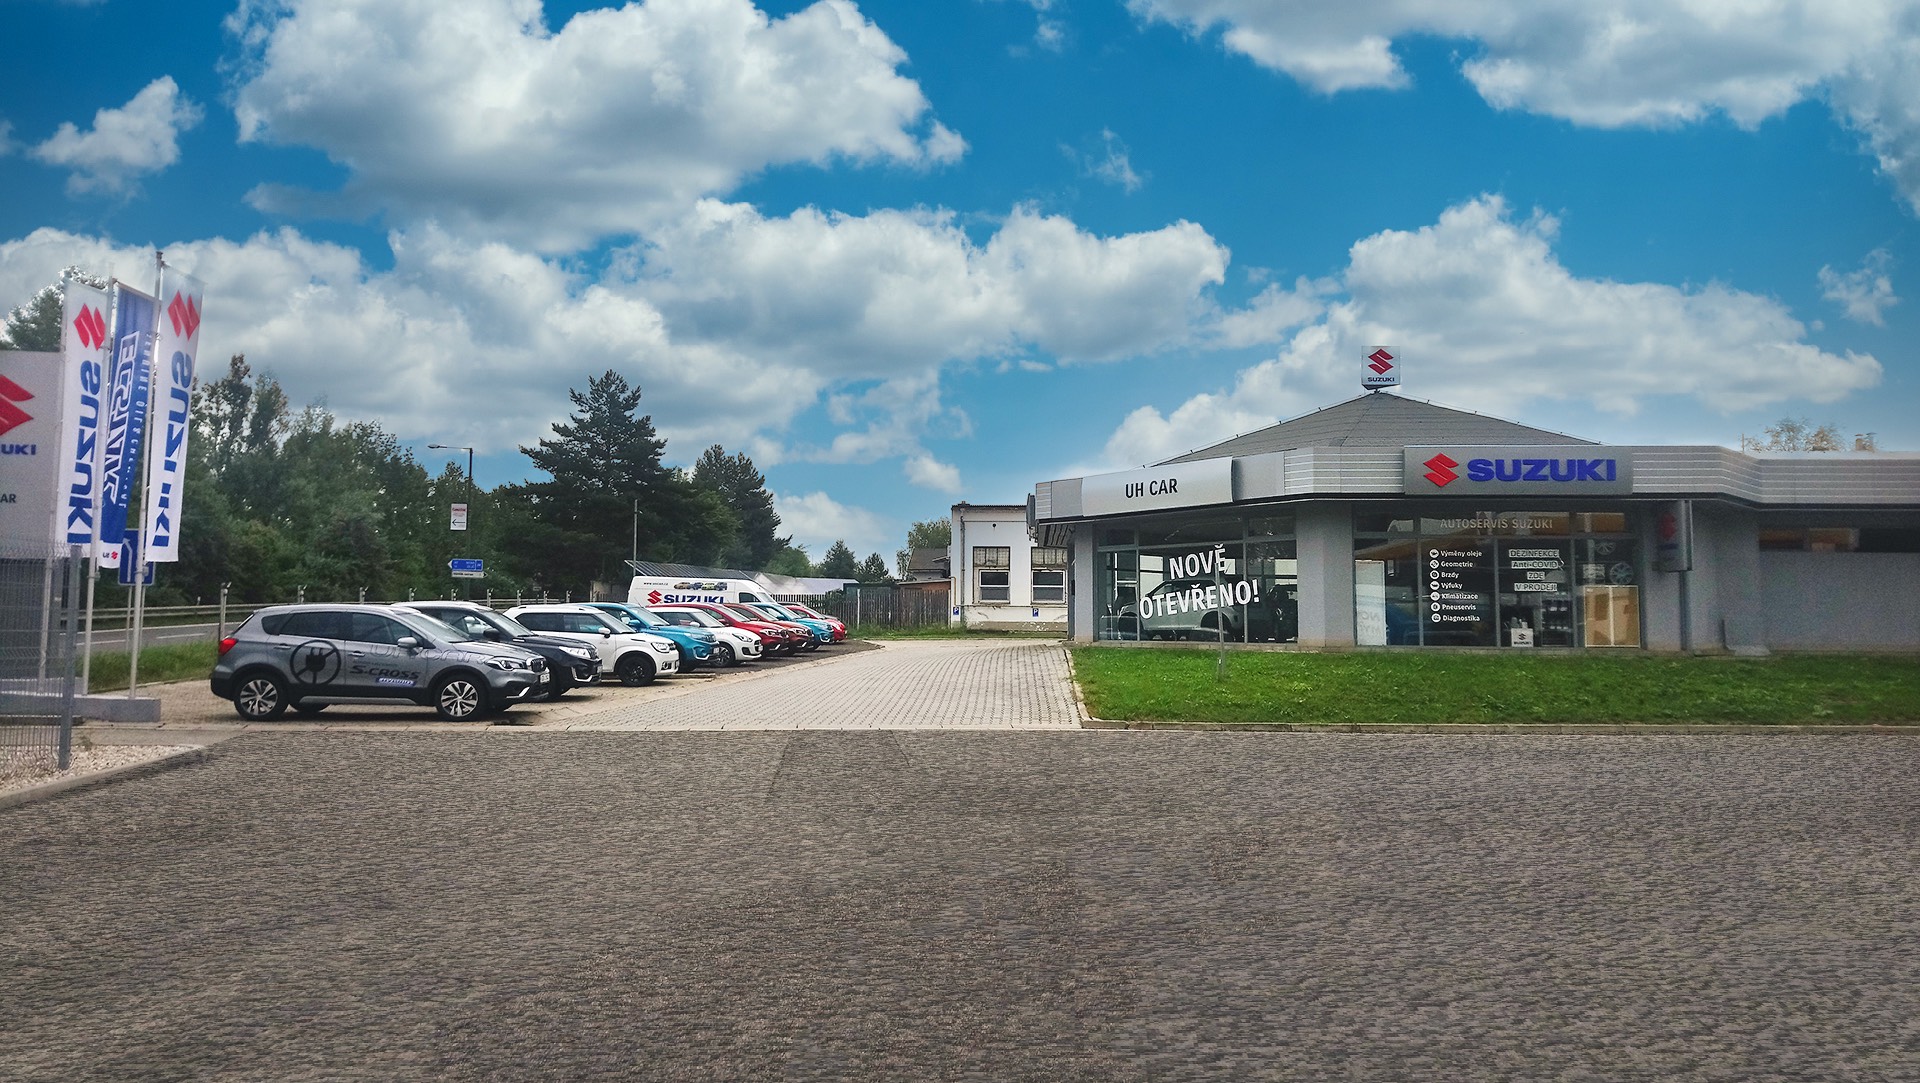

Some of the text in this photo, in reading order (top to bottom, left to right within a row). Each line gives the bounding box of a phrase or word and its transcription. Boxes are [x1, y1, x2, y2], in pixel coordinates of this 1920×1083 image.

[0, 444, 36, 455] UKI
[1467, 458, 1617, 482] SUZUKI
[1125, 478, 1178, 499] UH CAR
[0, 493, 16, 503] AR
[1440, 519, 1553, 529] AUTOSERVIS SUZUKI
[1510, 549, 1557, 557] DEZINFEKCE
[1169, 542, 1227, 580] NOVĚ
[664, 594, 724, 604] SUZUKI
[1139, 578, 1260, 619] OTEVŘENO!
